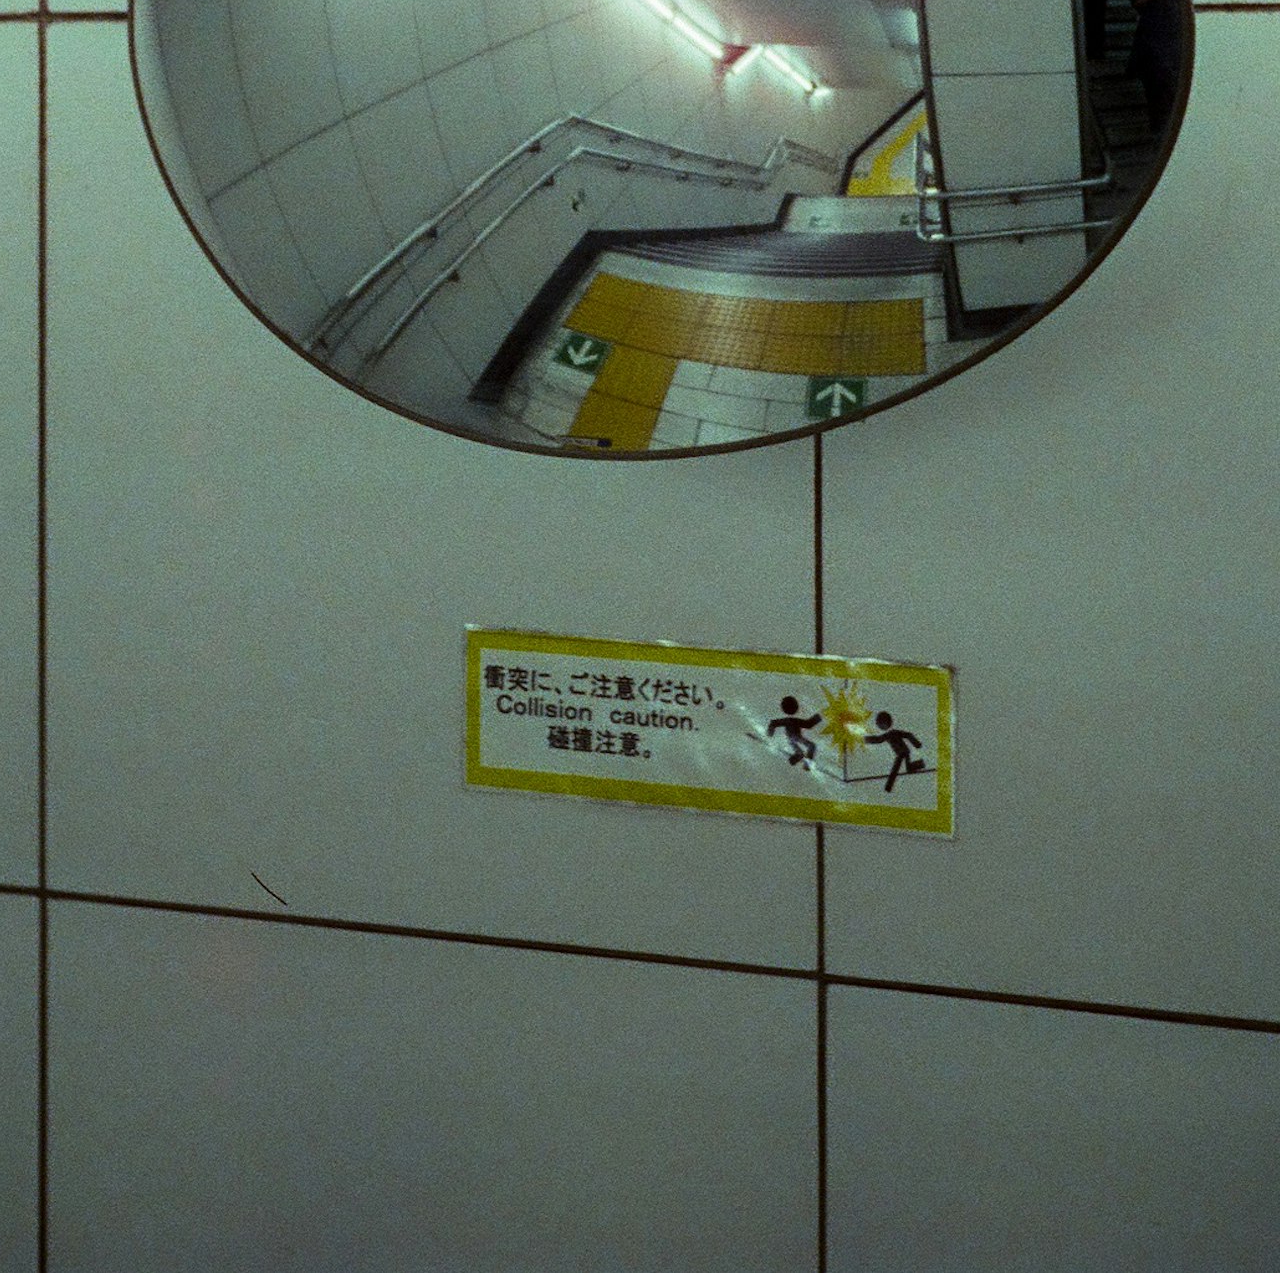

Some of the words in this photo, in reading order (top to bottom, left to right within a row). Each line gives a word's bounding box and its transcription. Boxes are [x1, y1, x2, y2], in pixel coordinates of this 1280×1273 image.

[484, 664, 725, 710] 衝突に、ご注意ください。
[496, 694, 593, 721] Collision
[609, 708, 699, 732] caution.
[547, 725, 652, 759] 碰撞注意。
